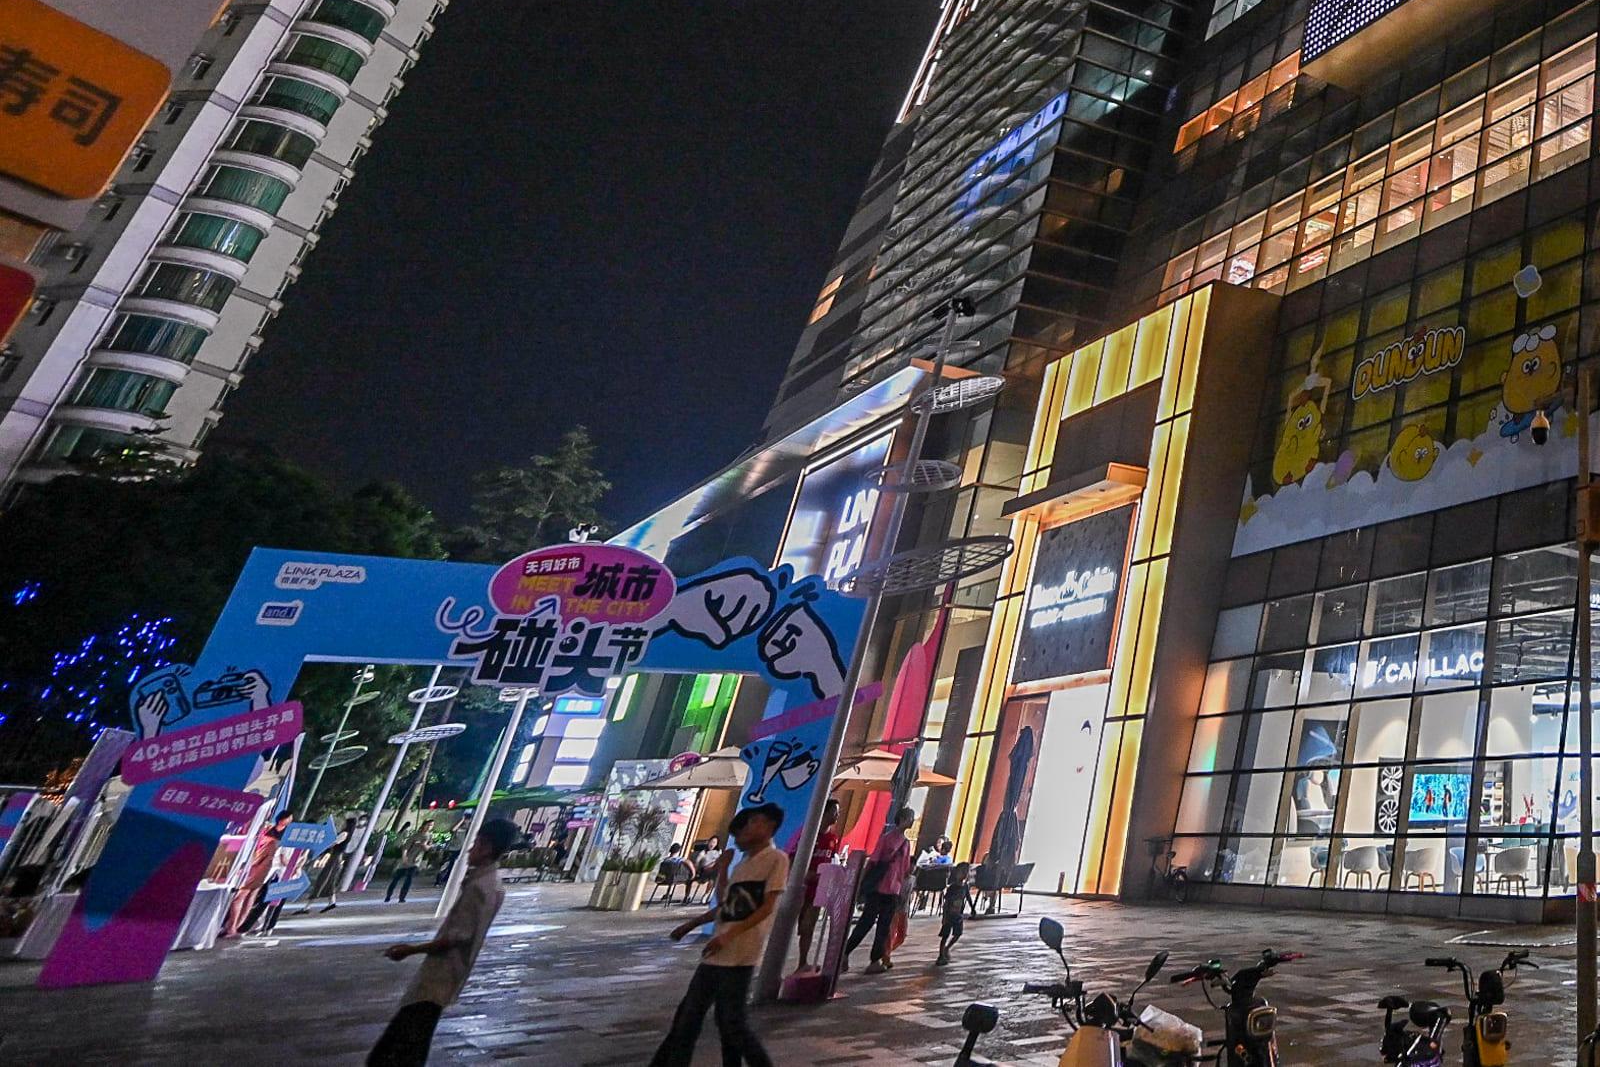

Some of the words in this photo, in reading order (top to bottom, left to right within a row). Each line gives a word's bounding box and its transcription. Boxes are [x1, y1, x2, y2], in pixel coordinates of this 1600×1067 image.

[284, 566, 317, 576] LINK
[319, 568, 362, 580] PLAZA
[525, 556, 582, 575] 天河好市
[518, 576, 577, 593] MEET
[573, 562, 662, 602] 城市
[510, 595, 533, 611] IN
[565, 598, 601, 615] THE
[605, 601, 652, 617] CITY
[453, 618, 651, 695] 碰头节
